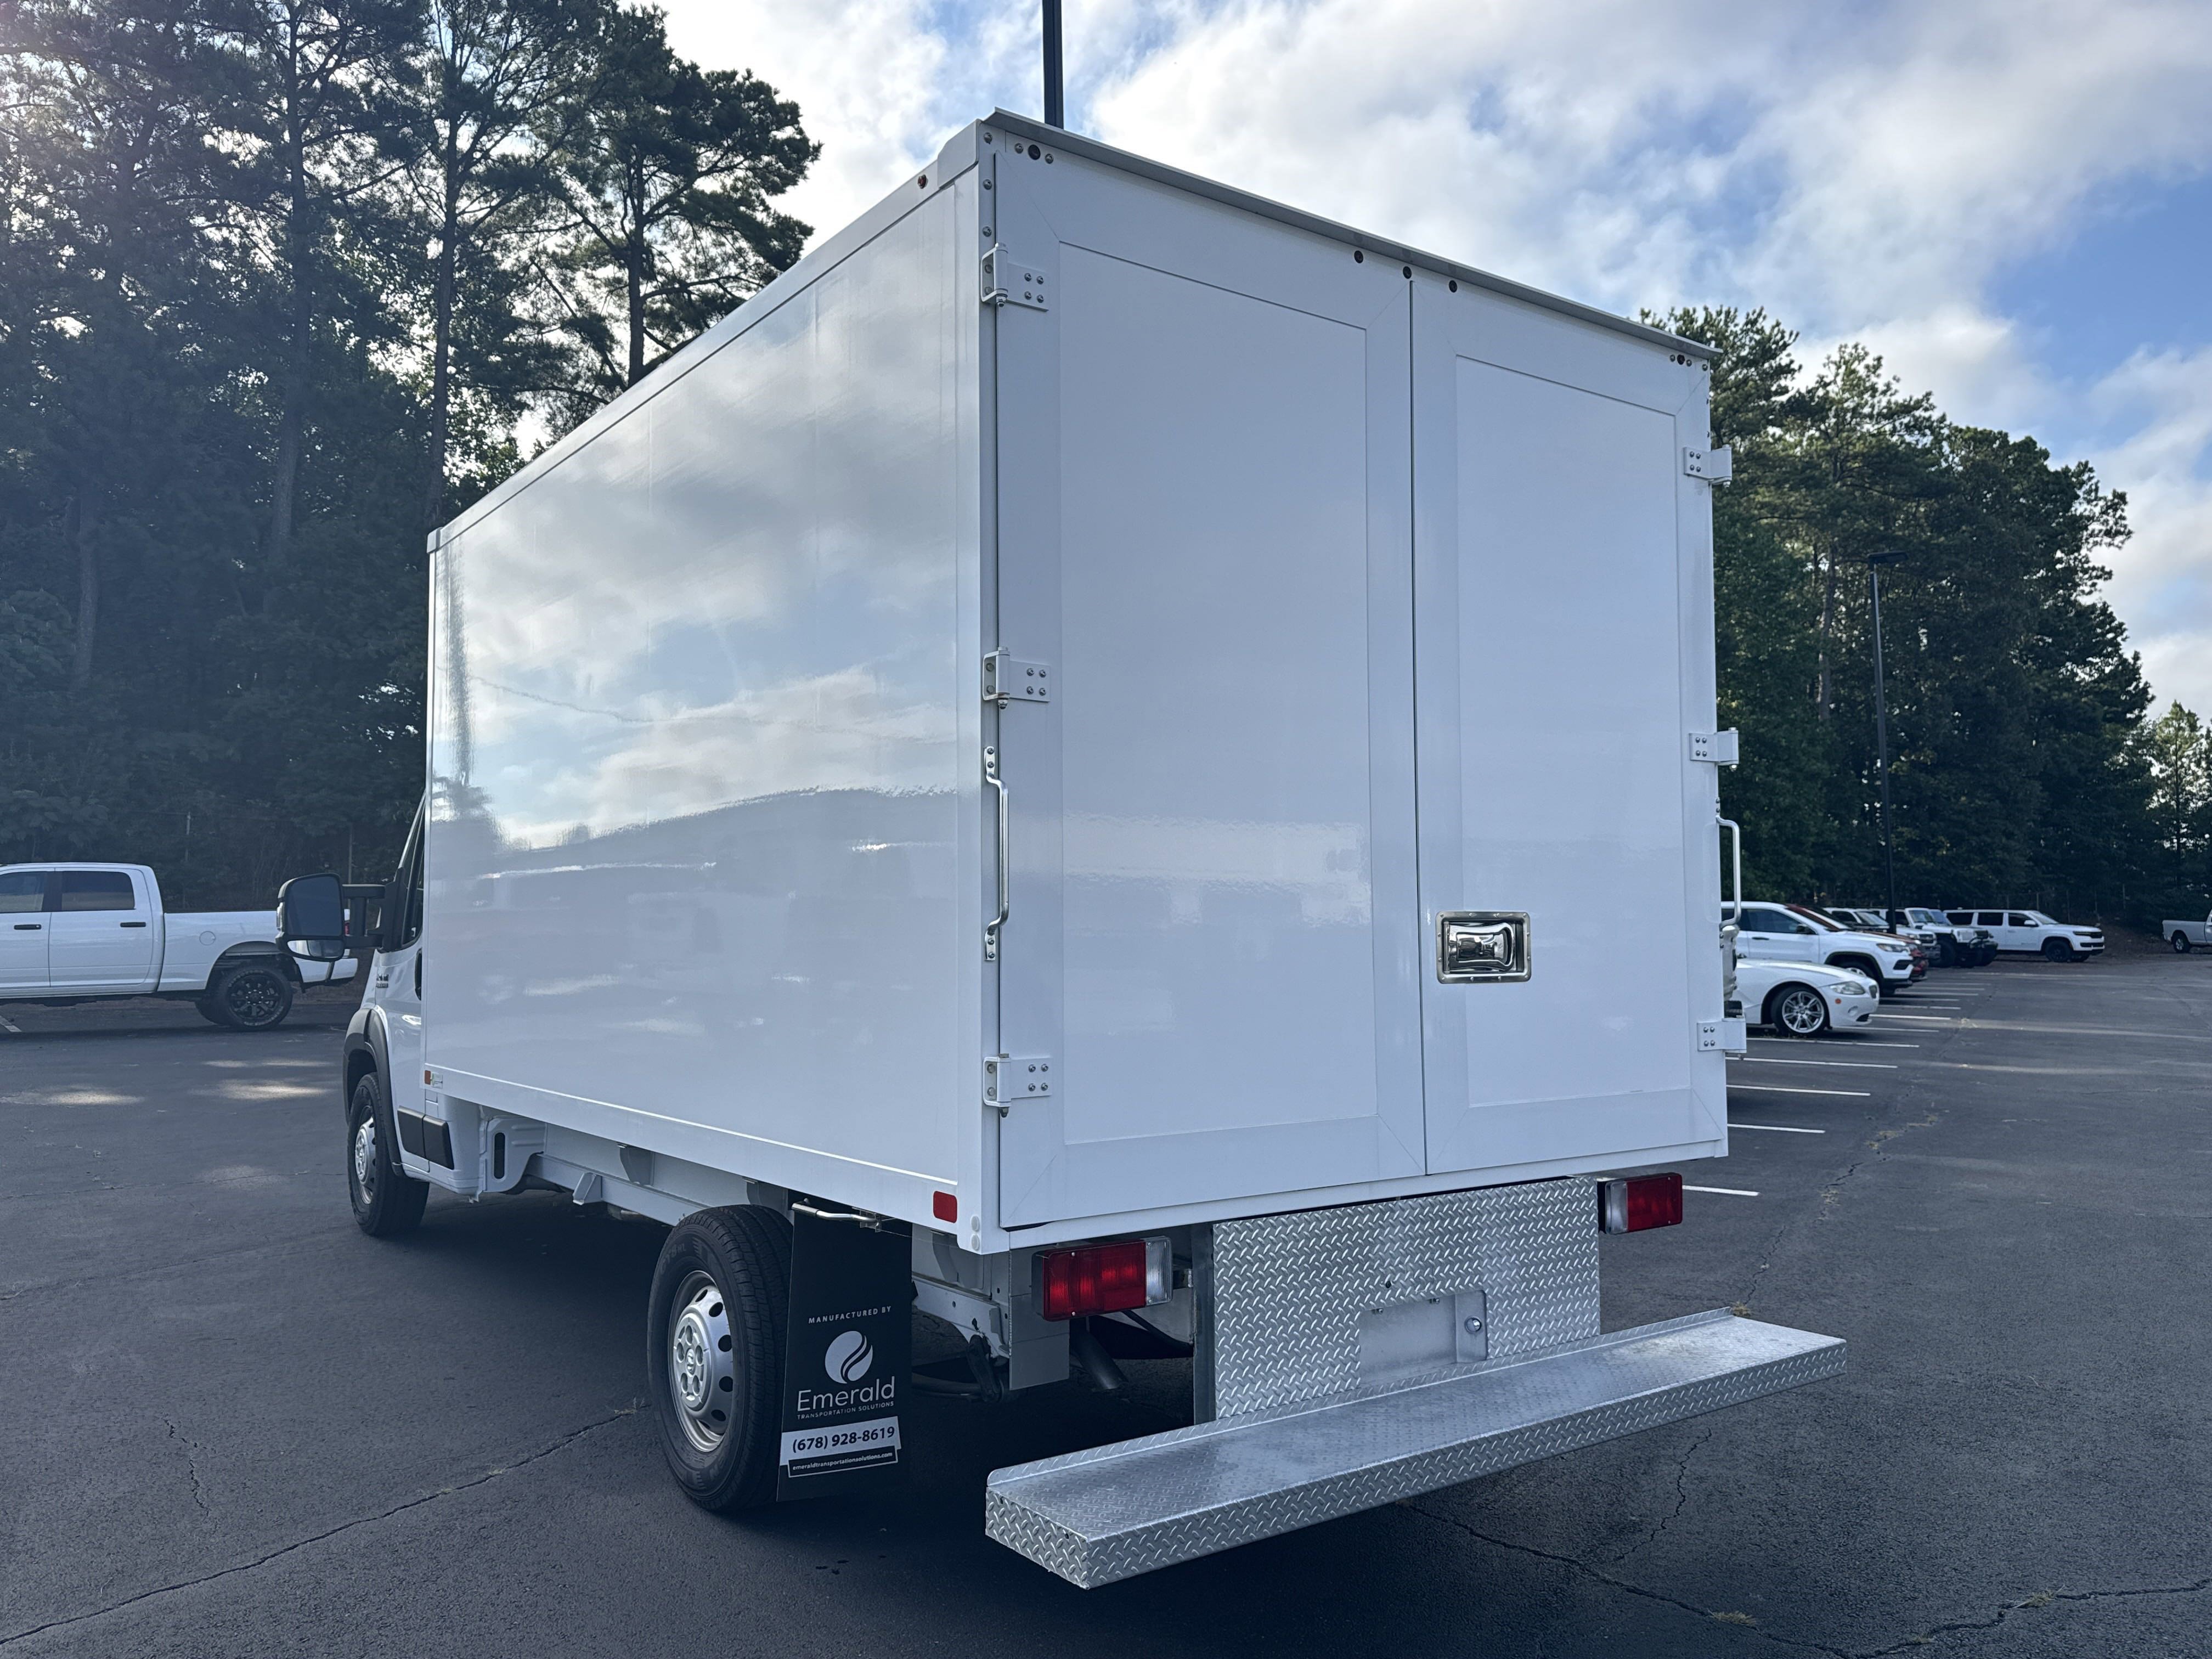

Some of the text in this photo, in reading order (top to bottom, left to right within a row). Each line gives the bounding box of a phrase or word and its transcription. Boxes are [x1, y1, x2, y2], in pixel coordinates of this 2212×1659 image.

[808, 1308, 878, 1324] MANUFACTURED
[797, 1376, 895, 1412] Emerald
[797, 1401, 894, 1420] TRANSPORTATION SOLUTIONS
[792, 1426, 895, 1453] (678) 928-8619
[792, 1452, 893, 1470] emeraldtransportationsolutions.com
